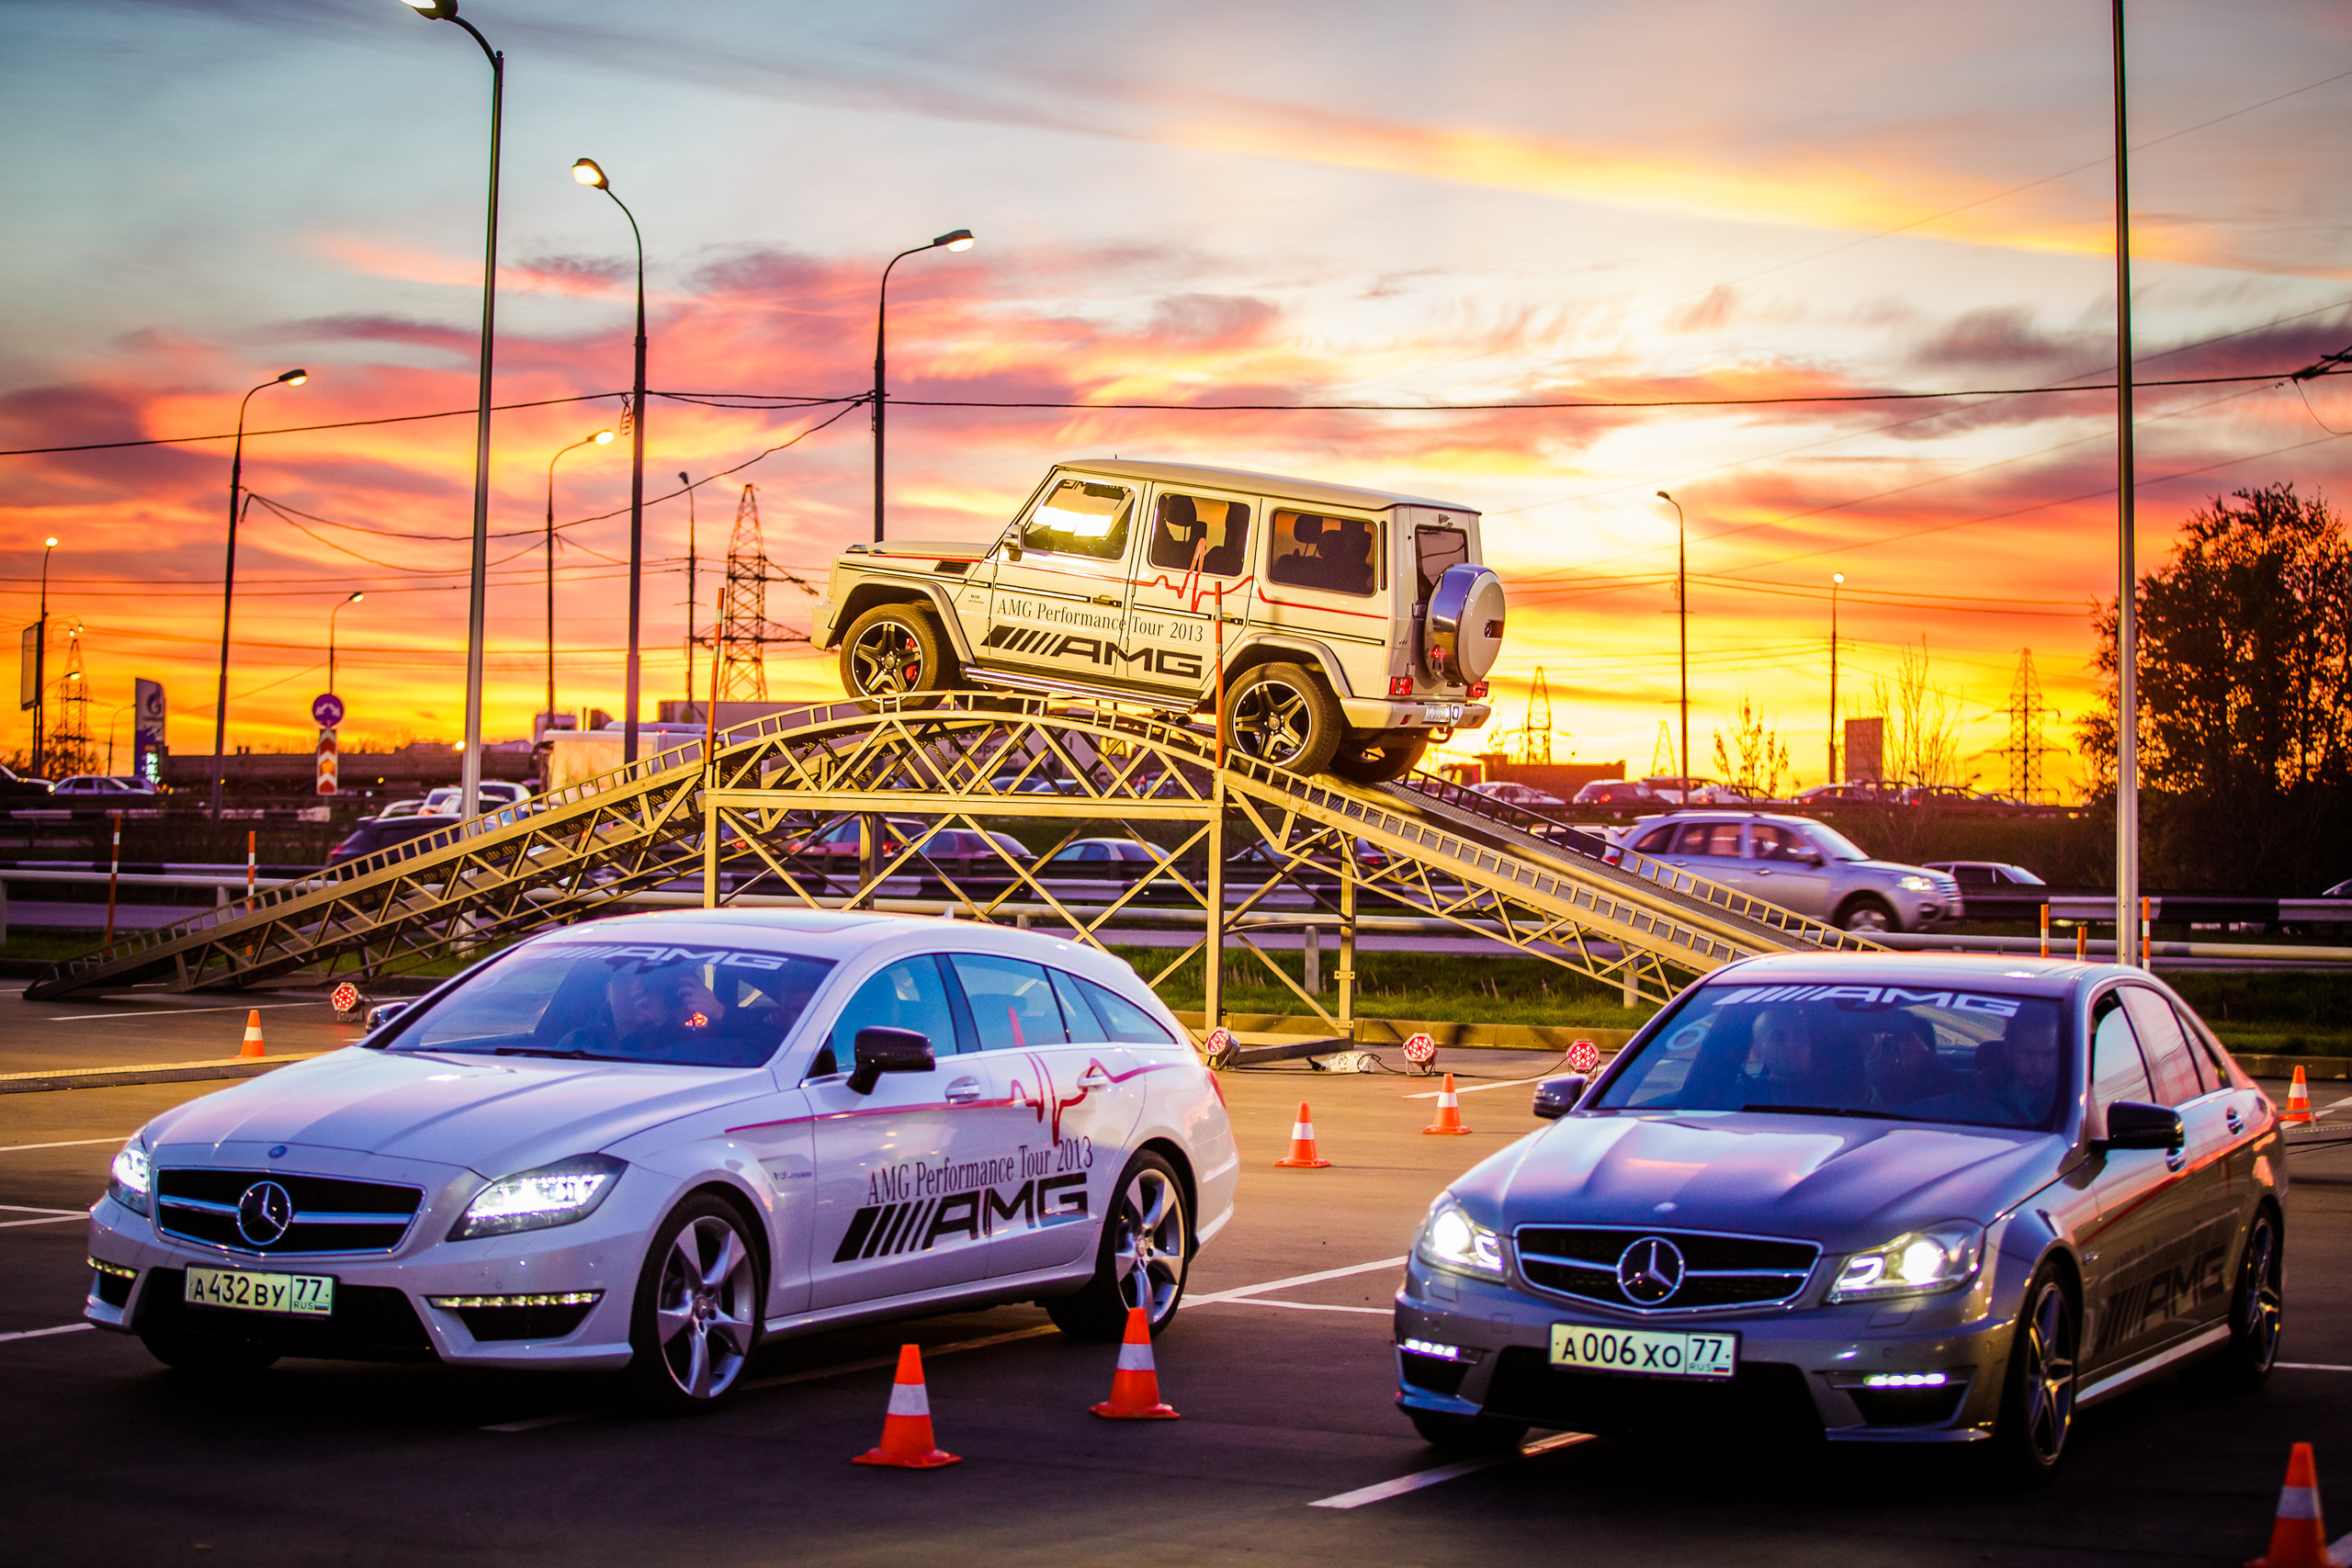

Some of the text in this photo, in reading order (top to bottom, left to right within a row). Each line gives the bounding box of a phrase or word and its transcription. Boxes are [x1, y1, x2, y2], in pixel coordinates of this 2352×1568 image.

[997, 598, 1033, 618] AMG
[1037, 603, 1126, 631] Performance
[1132, 615, 1163, 637] Tour
[1170, 622, 1204, 642] 2013
[866, 1135, 1093, 1205] AMG Performance Tour 2013
[295, 1278, 322, 1301] 77
[293, 1301, 314, 1311] RUS
[1691, 1338, 1723, 1362] 77
[1689, 1362, 1712, 1372] RUS
